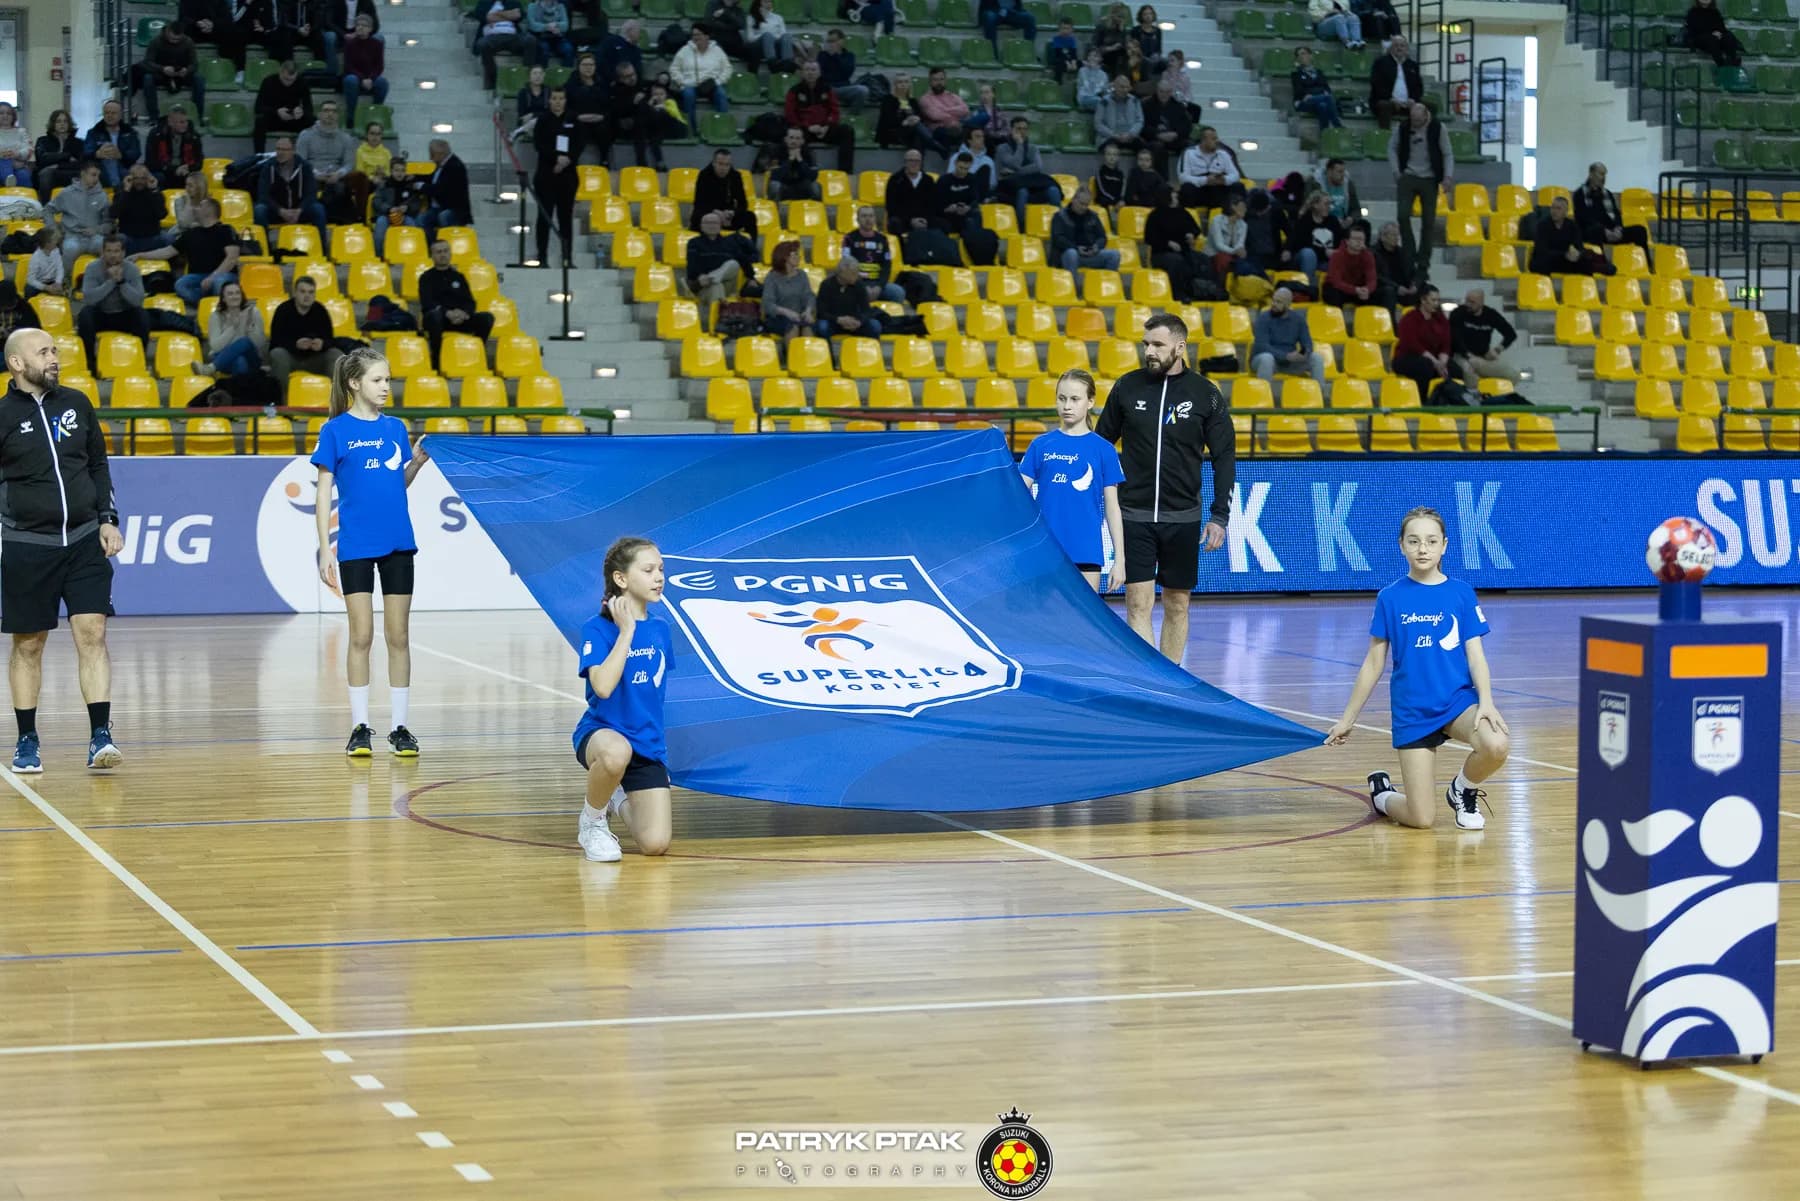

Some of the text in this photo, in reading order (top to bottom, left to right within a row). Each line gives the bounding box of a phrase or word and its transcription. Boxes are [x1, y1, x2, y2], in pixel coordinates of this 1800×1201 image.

[347, 437, 384, 450] Zobaczyć
[364, 458, 380, 470] Lili
[1043, 452, 1079, 464] Zobaczyć
[1051, 473, 1068, 483] Lili
[1312, 482, 1371, 571] K
[1454, 481, 1514, 569] K
[1696, 477, 1800, 568] SU
[733, 573, 909, 593] PGNiG
[1400, 611, 1444, 626] Zobaczyć
[1414, 635, 1433, 647] Lili
[626, 645, 656, 660] baczyć
[631, 670, 649, 684] Lili
[757, 661, 988, 685] SUPERLIGA
[825, 681, 942, 694] KOBIET
